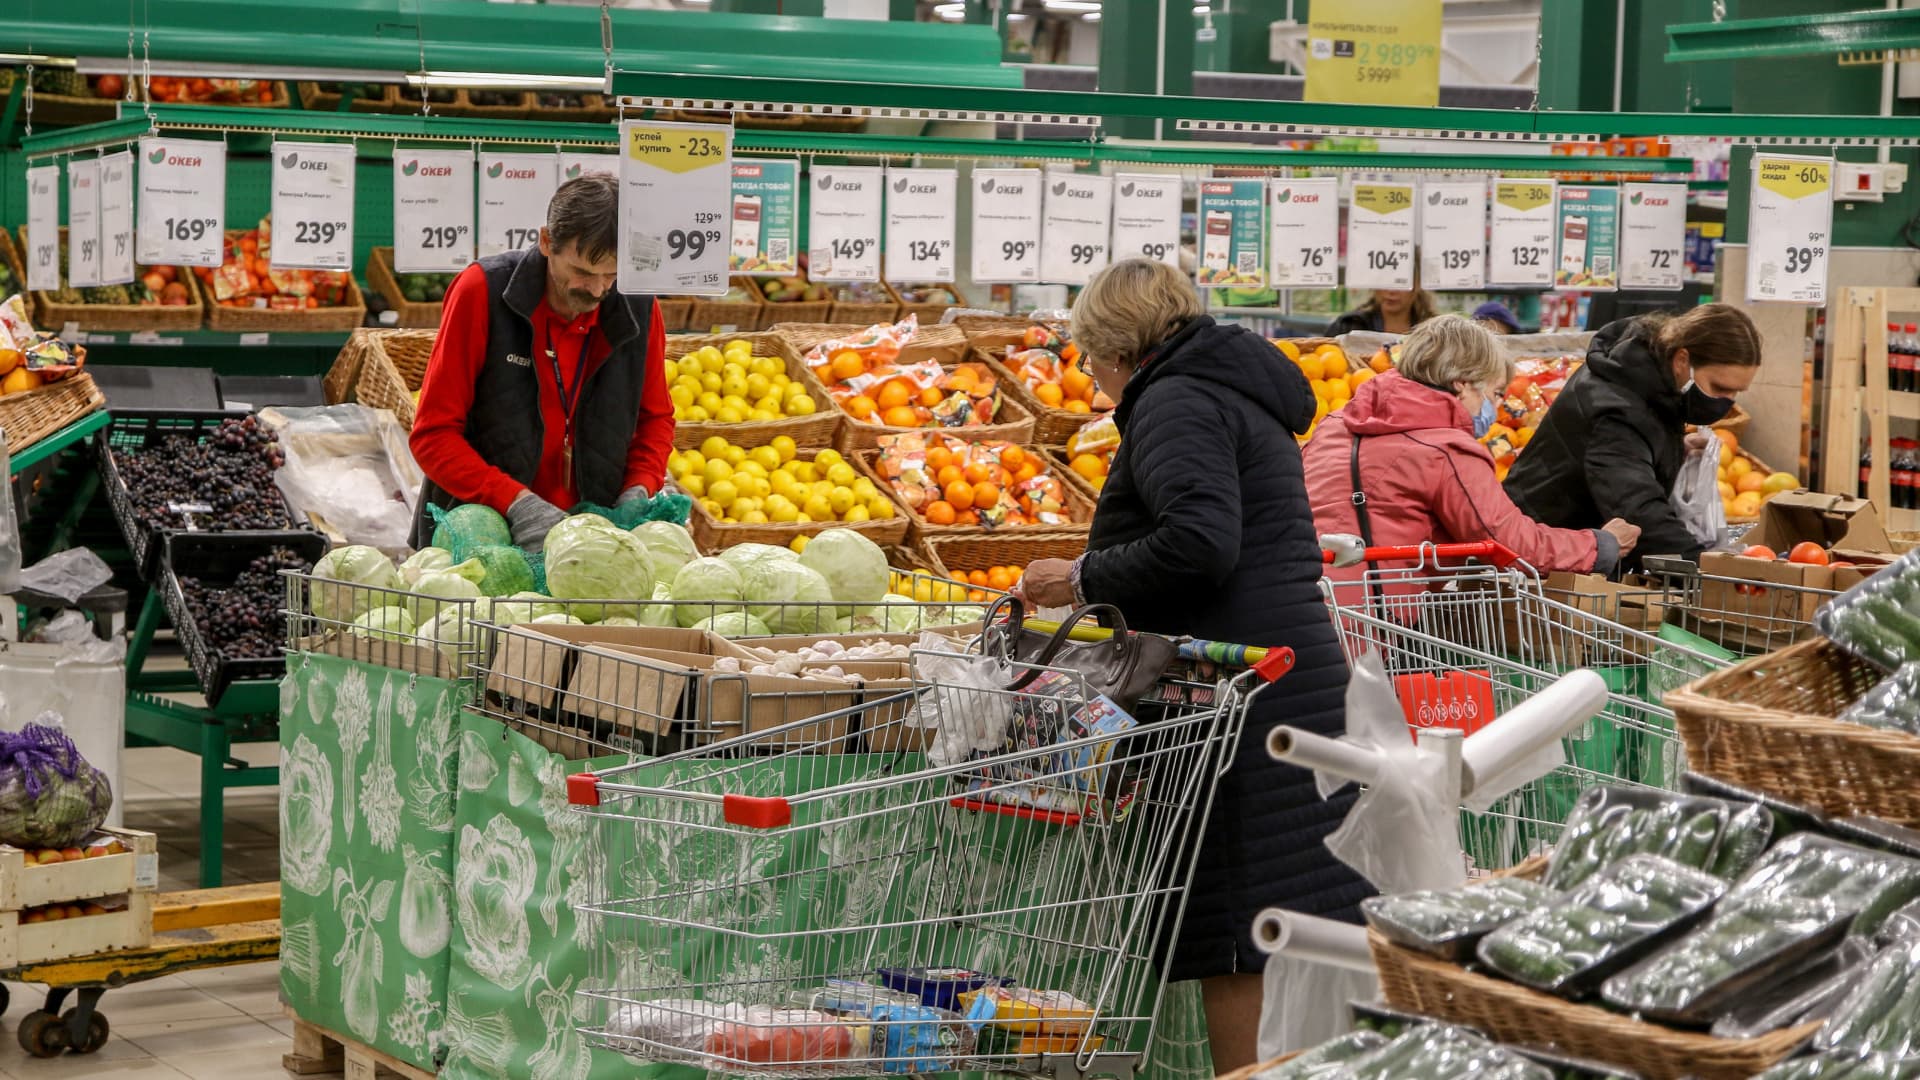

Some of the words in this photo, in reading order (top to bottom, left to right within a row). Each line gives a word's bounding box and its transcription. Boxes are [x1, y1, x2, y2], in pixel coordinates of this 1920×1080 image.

[634, 132, 662, 141] успей
[639, 144, 671, 153] купить
[679, 137, 722, 157] -23%
[165, 218, 205, 241] 169
[205, 219, 217, 228] 99
[295, 221, 335, 244] 239
[335, 222, 347, 231] 99
[422, 227, 457, 248] 219
[457, 226, 468, 235] 99
[667, 229, 706, 260] 99
[706, 231, 721, 242] 99
[832, 239, 865, 260] 149
[909, 241, 941, 261] 134
[1002, 241, 1026, 261] 99
[1070, 245, 1094, 265] 99
[1300, 248, 1323, 268] 76
[1368, 250, 1399, 270] 104
[1442, 250, 1471, 269] 139
[1511, 247, 1540, 266] 132
[1650, 250, 1670, 269] 72
[1784, 247, 1812, 274] 39
[1812, 248, 1824, 258] 99
